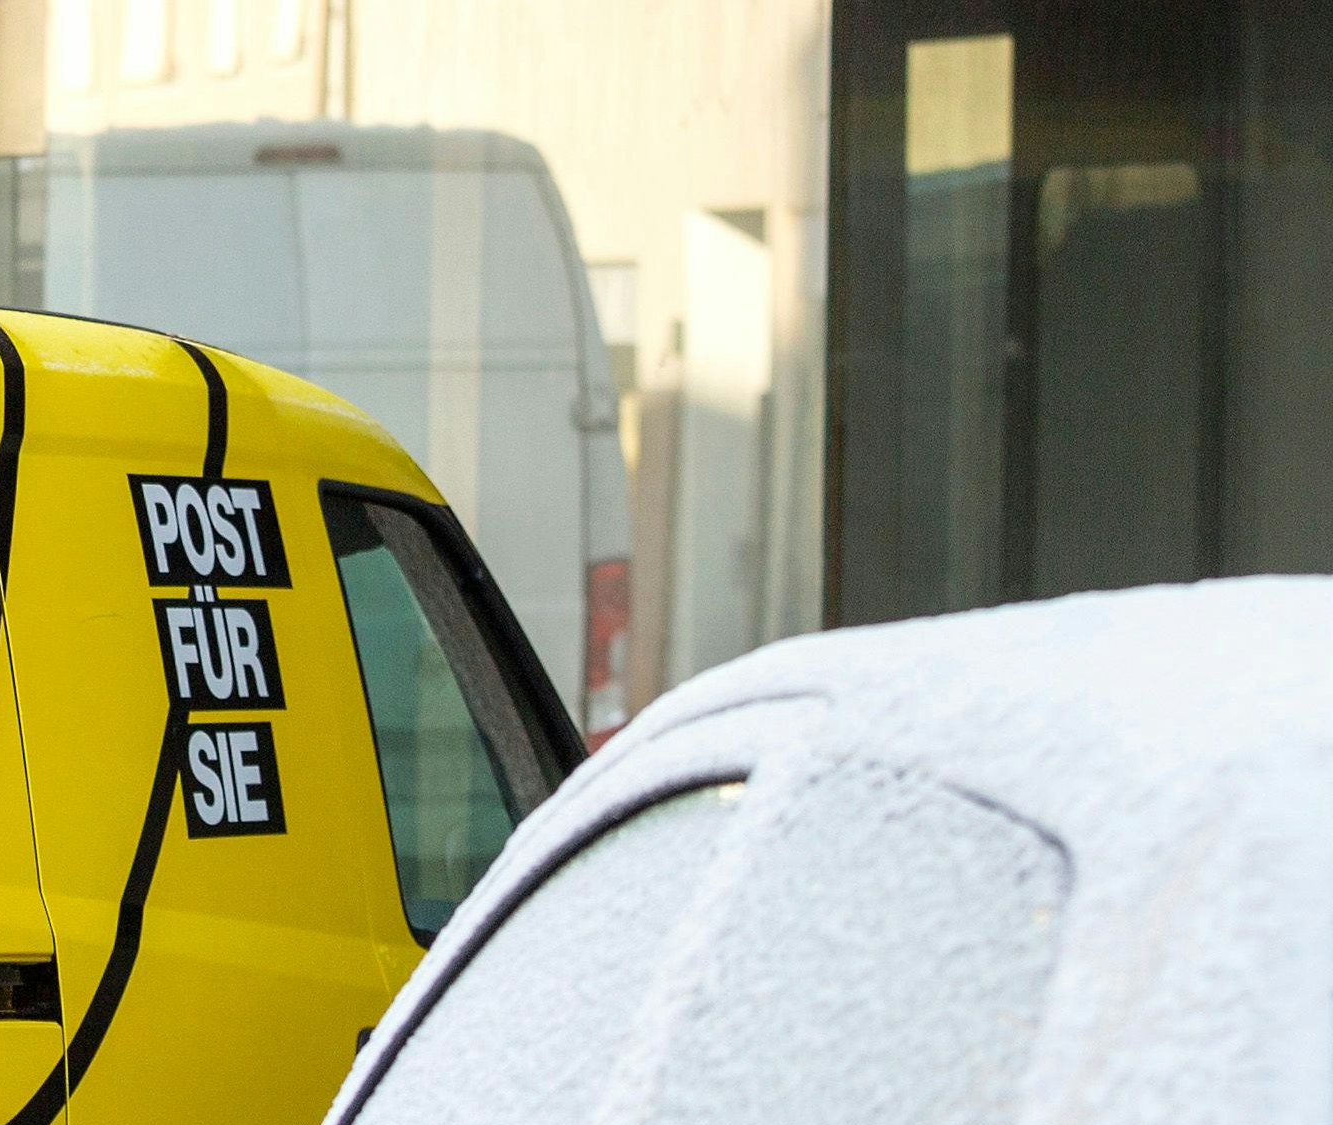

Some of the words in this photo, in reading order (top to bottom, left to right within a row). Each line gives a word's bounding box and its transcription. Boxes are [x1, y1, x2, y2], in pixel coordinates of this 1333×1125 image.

[142, 483, 267, 577] POST
[166, 585, 269, 700] FÜR
[188, 730, 270, 826] SIE
